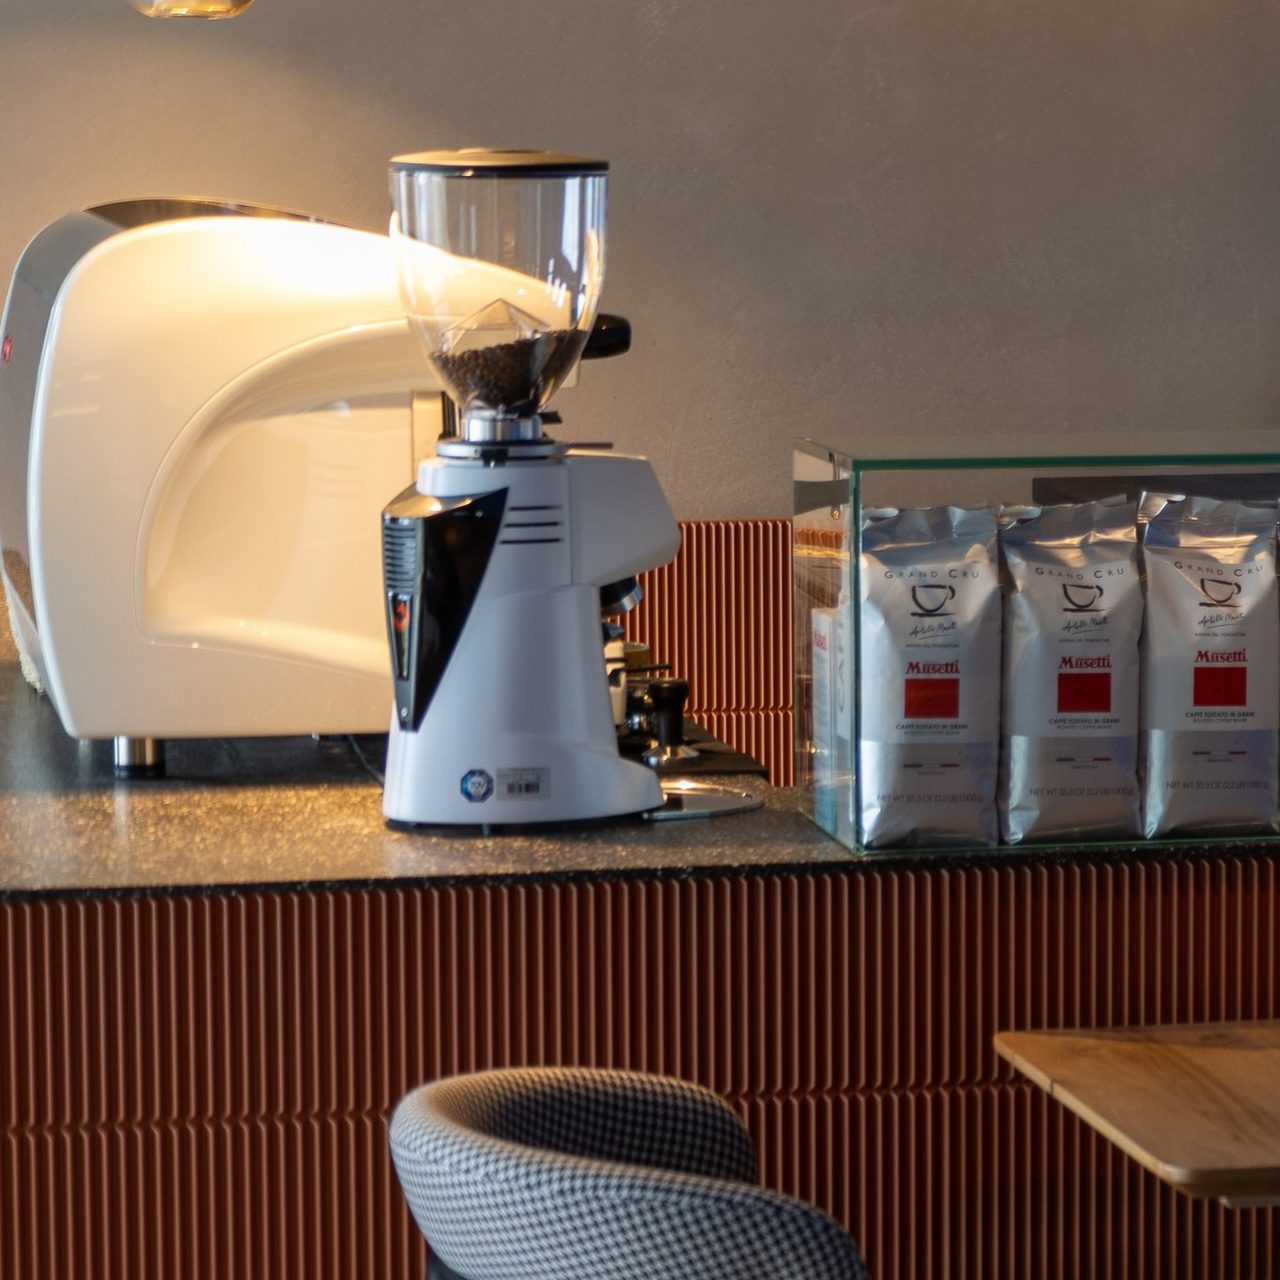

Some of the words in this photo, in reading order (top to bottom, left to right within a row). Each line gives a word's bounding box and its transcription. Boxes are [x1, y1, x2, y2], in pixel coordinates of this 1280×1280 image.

[949, 569, 980, 579] CRU
[1094, 568, 1124, 579] CRU
[1234, 565, 1263, 577] CRU
[1058, 654, 1112, 669] Musetti
[1194, 649, 1247, 663] Musetti
[905, 660, 960, 674] Musetti
